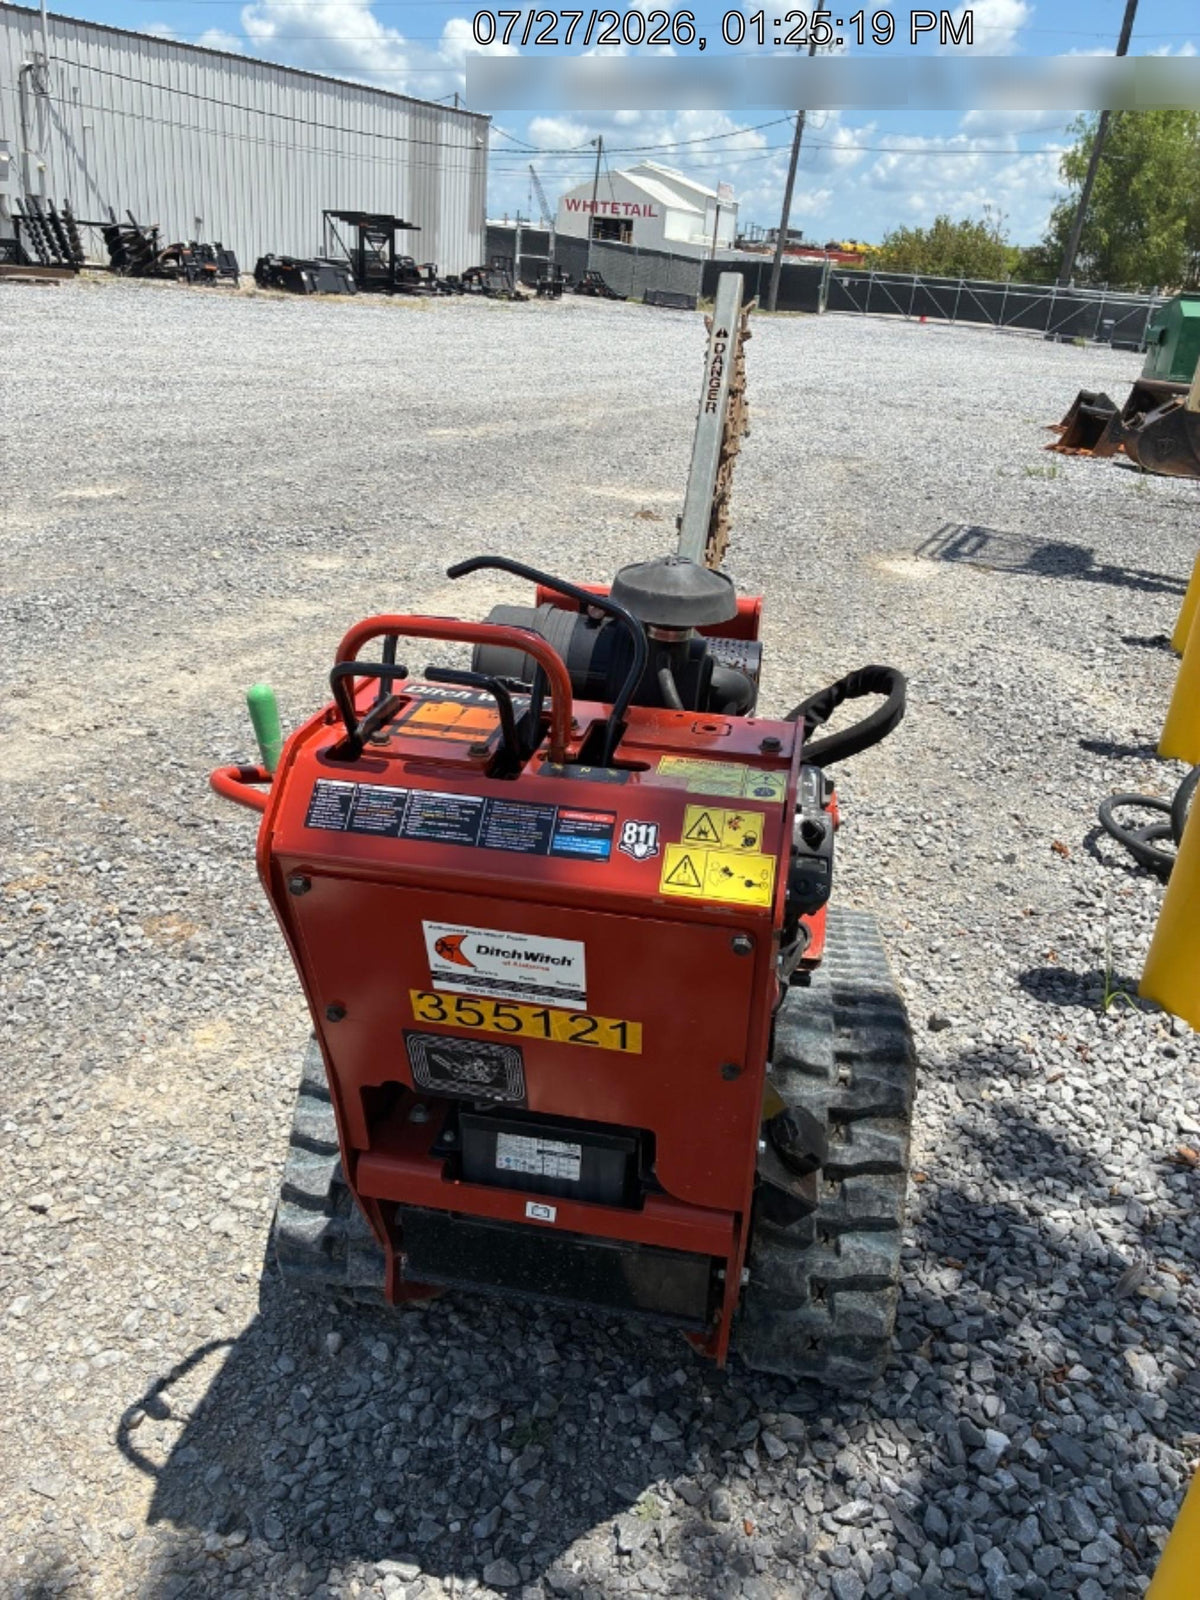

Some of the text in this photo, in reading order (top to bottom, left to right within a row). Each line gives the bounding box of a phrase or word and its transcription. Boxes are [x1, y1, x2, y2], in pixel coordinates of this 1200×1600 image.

[565, 199, 658, 218] WHITETAIL
[705, 342, 726, 414] DANGER
[403, 685, 473, 700] Ditch
[623, 822, 657, 847] 811
[476, 944, 572, 967] Ditch Witch
[416, 993, 628, 1050] 355121
